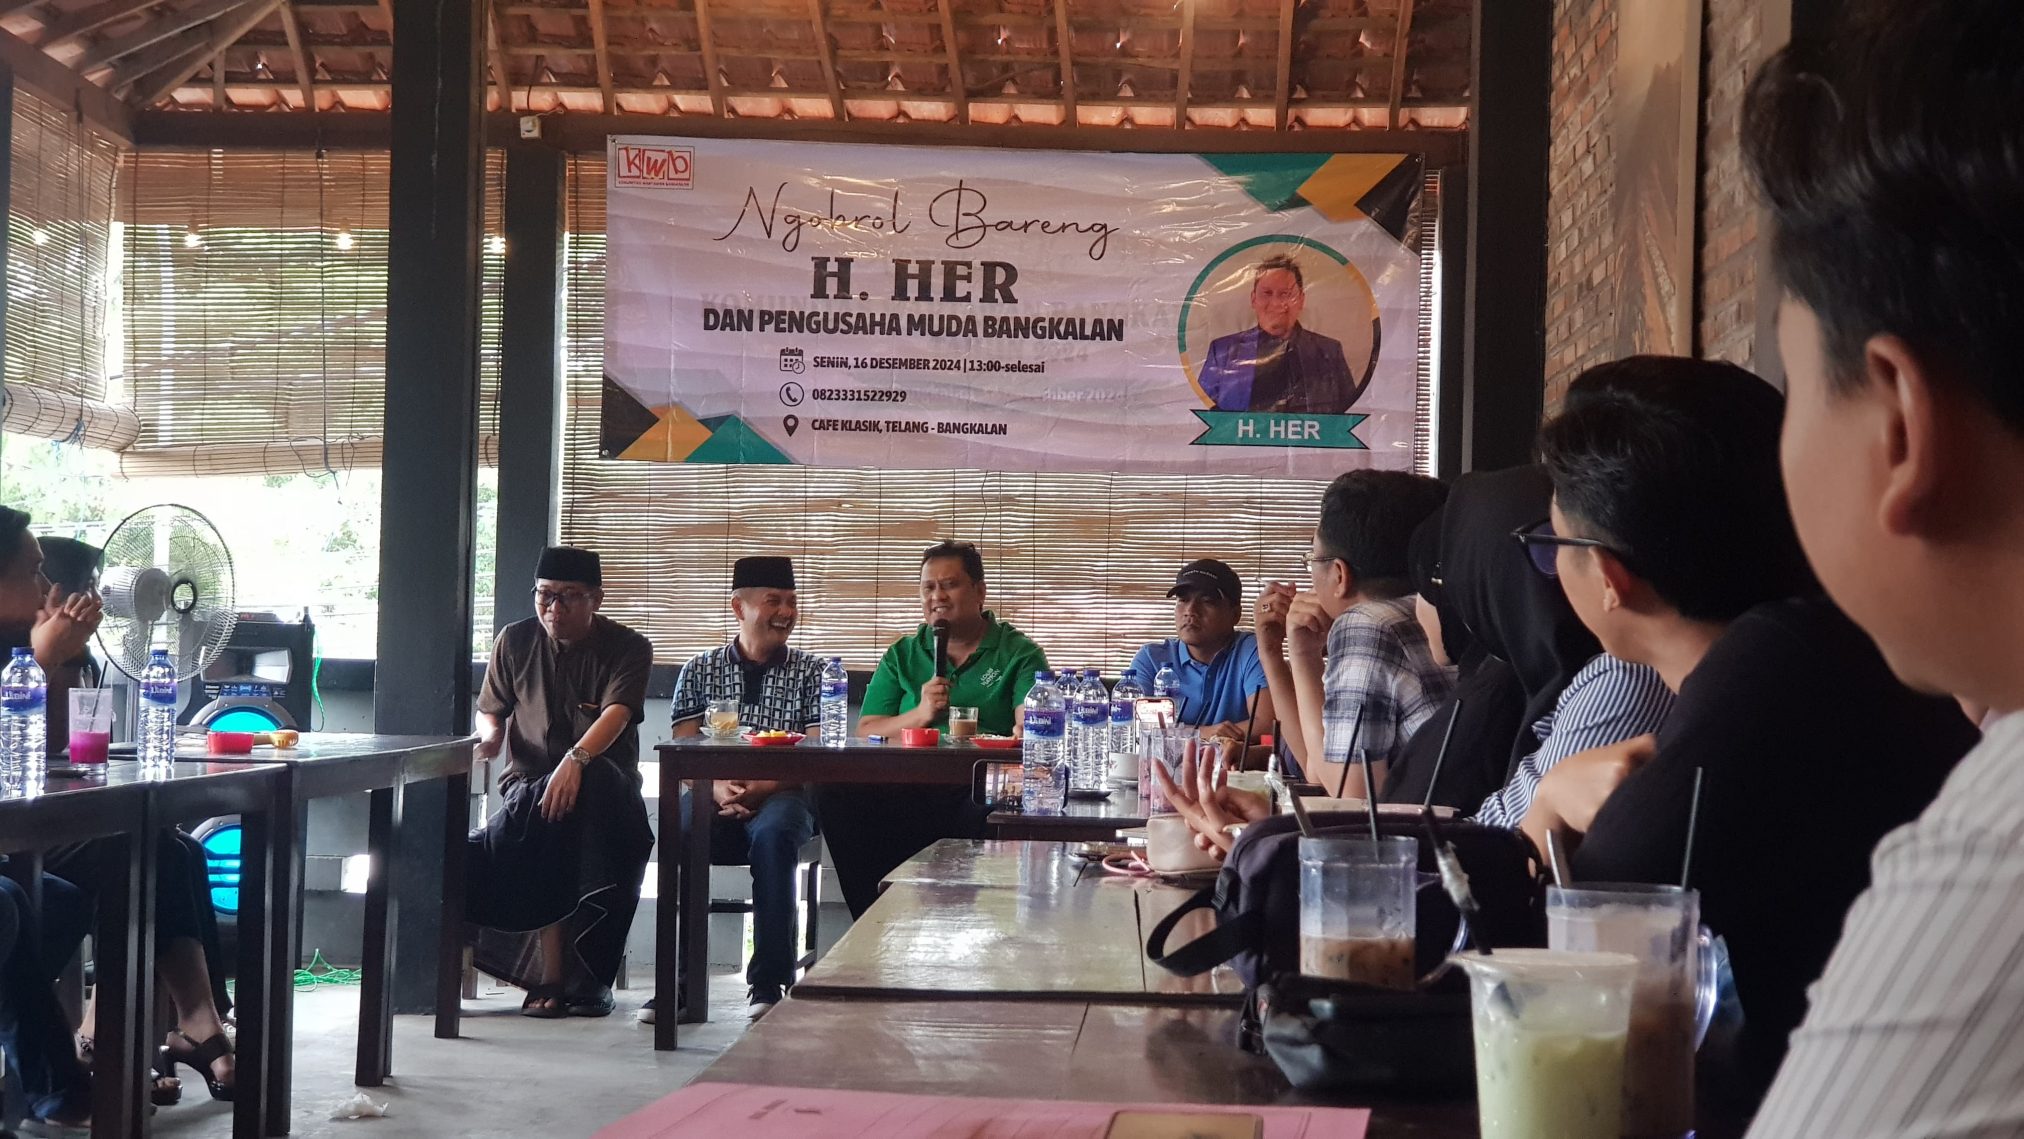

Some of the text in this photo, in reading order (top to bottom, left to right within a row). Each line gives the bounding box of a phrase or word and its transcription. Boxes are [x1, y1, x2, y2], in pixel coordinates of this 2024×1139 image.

[713, 179, 1120, 261] Ngobrol Bareng
[810, 256, 1018, 304] H. HER
[703, 308, 1124, 342] DAN PENGUSAHA MUDA BANGKALAN
[854, 357, 868, 369] 16
[869, 357, 930, 371] DESEMBER
[932, 359, 962, 371] 2024
[812, 388, 907, 402] 0823331522929
[811, 418, 839, 431] CAFE
[840, 419, 882, 435] KLASIK,
[885, 420, 928, 433] TELANG
[937, 422, 1007, 435] BANGKALAN
[1237, 419, 1320, 440] H. HER
